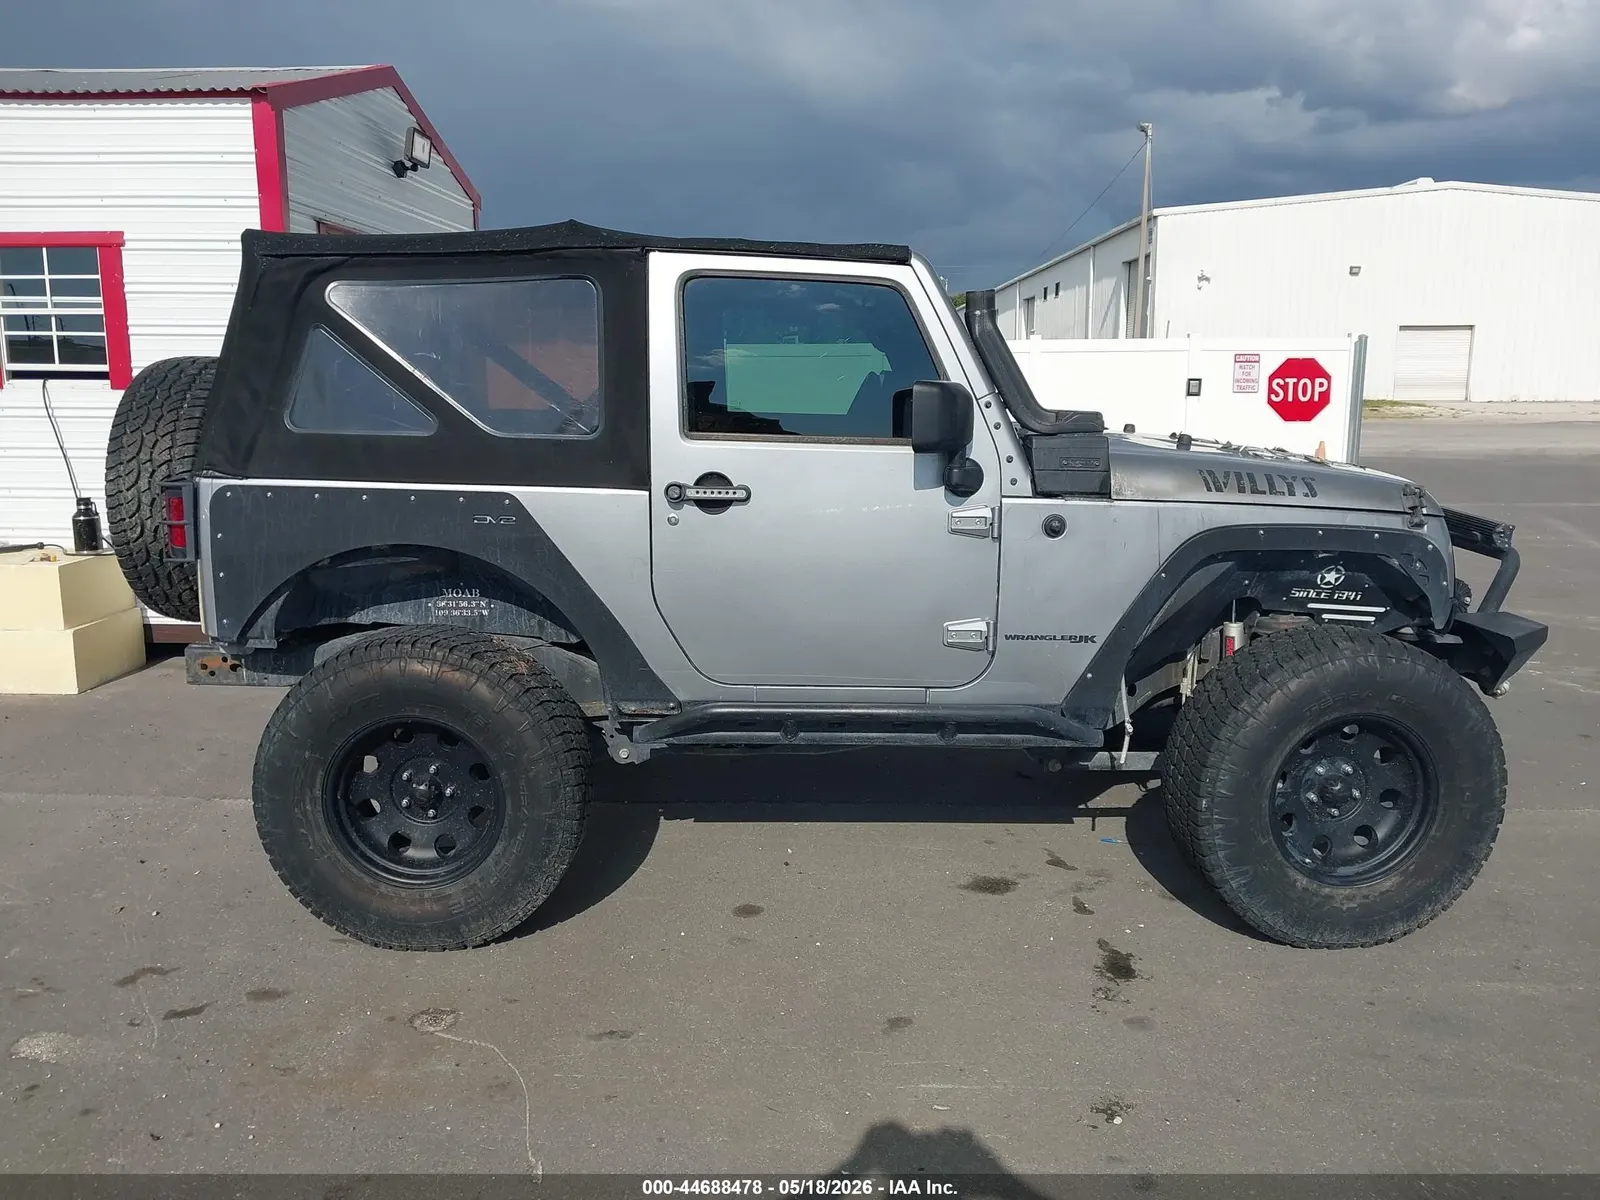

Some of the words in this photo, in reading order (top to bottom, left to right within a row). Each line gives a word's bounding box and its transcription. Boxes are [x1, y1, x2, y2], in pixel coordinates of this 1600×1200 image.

[1270, 377, 1328, 403] STOP
[1196, 468, 1318, 498] WILLYS
[442, 588, 480, 598] MOAB
[1289, 587, 1332, 599] SINCE
[1333, 590, 1363, 601] 1941
